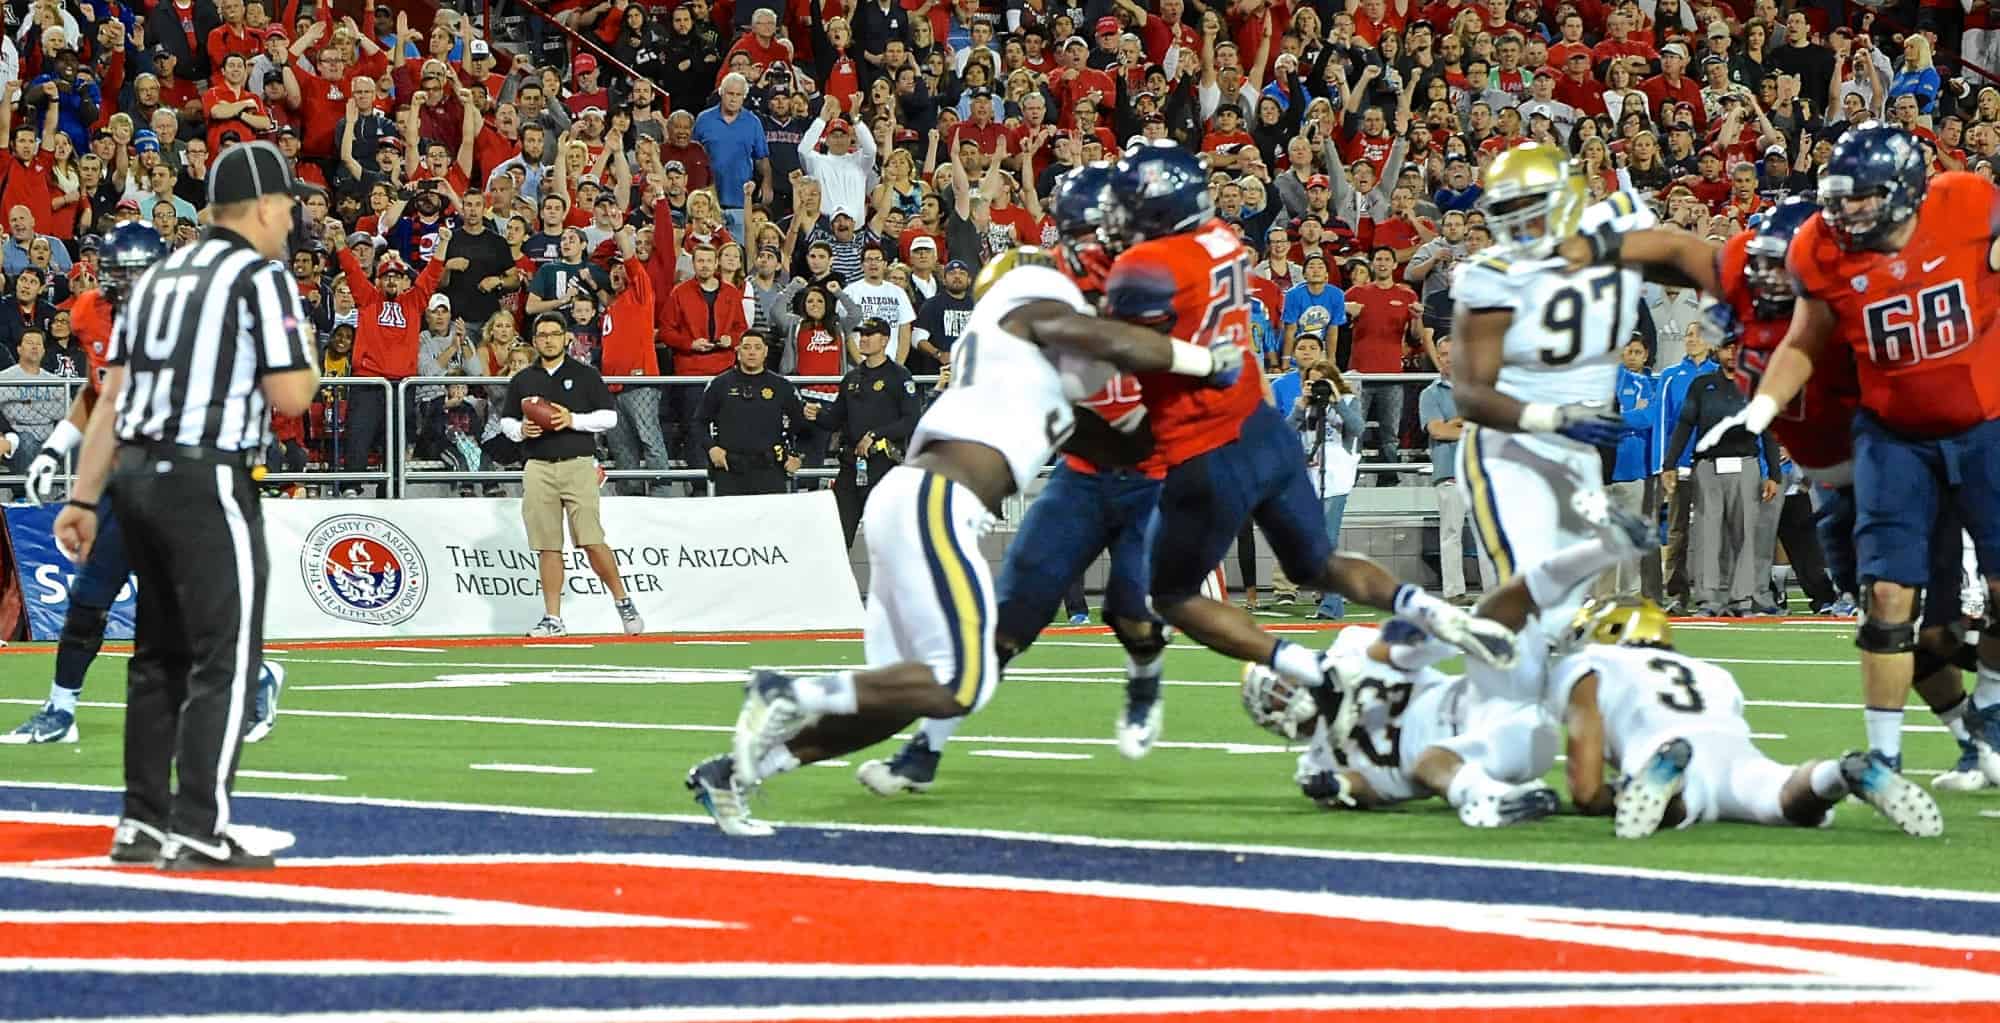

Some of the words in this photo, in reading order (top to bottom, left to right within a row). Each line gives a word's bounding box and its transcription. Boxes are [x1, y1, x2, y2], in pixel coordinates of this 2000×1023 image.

[144, 275, 199, 360] U
[1540, 270, 1622, 366] 97
[1863, 278, 1974, 368] 68
[382, 531, 419, 578] ARIZONA
[446, 545, 495, 568] THE
[499, 547, 634, 571] UNERTY
[642, 547, 669, 567] OF
[678, 544, 789, 568] ARIZONA
[1647, 657, 1705, 714] 3
